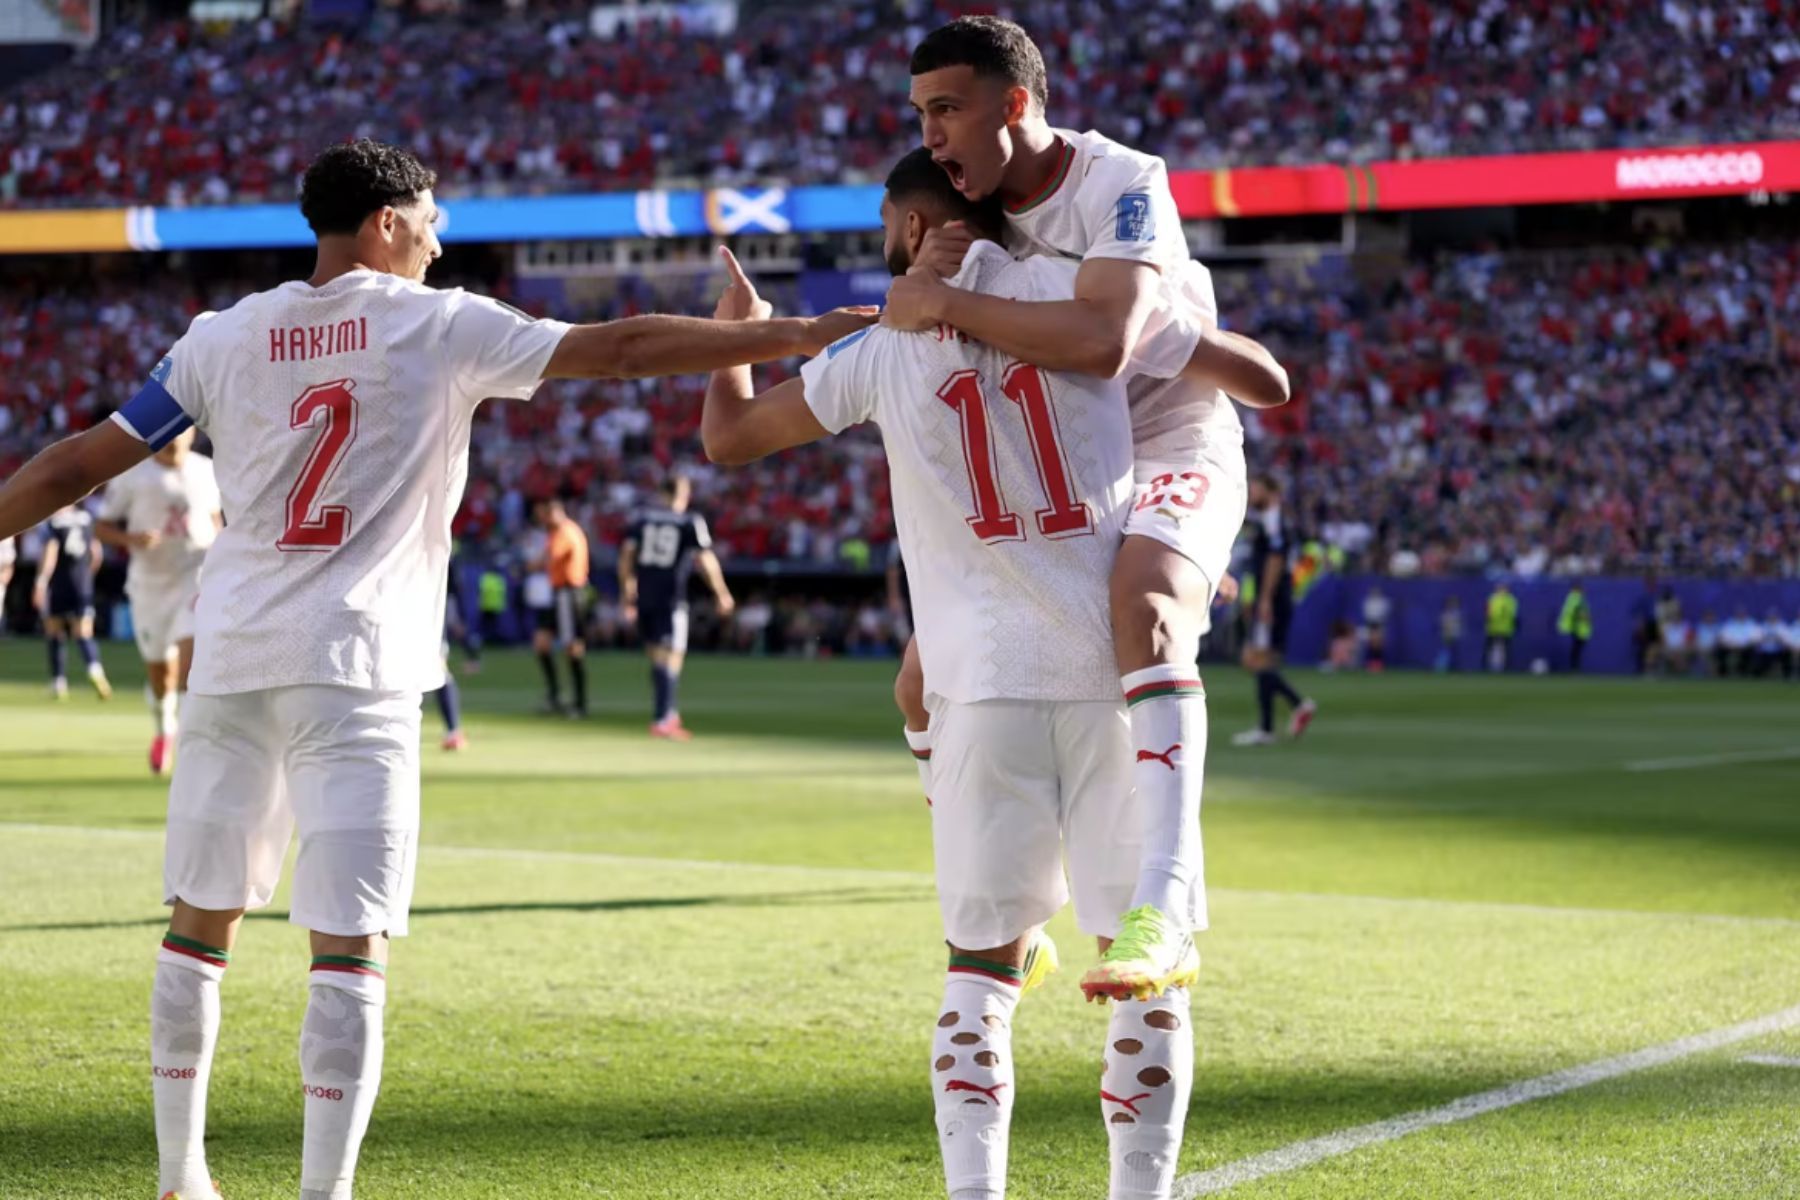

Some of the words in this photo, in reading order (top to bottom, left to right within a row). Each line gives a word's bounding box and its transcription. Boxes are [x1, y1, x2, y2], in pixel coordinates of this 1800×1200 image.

[1616, 151, 1764, 190] MOROCCO
[269, 317, 367, 362] HAKIMI
[276, 378, 359, 552] 2
[936, 361, 1095, 546] 11
[1134, 472, 1210, 511] 23
[640, 523, 680, 568] 19
